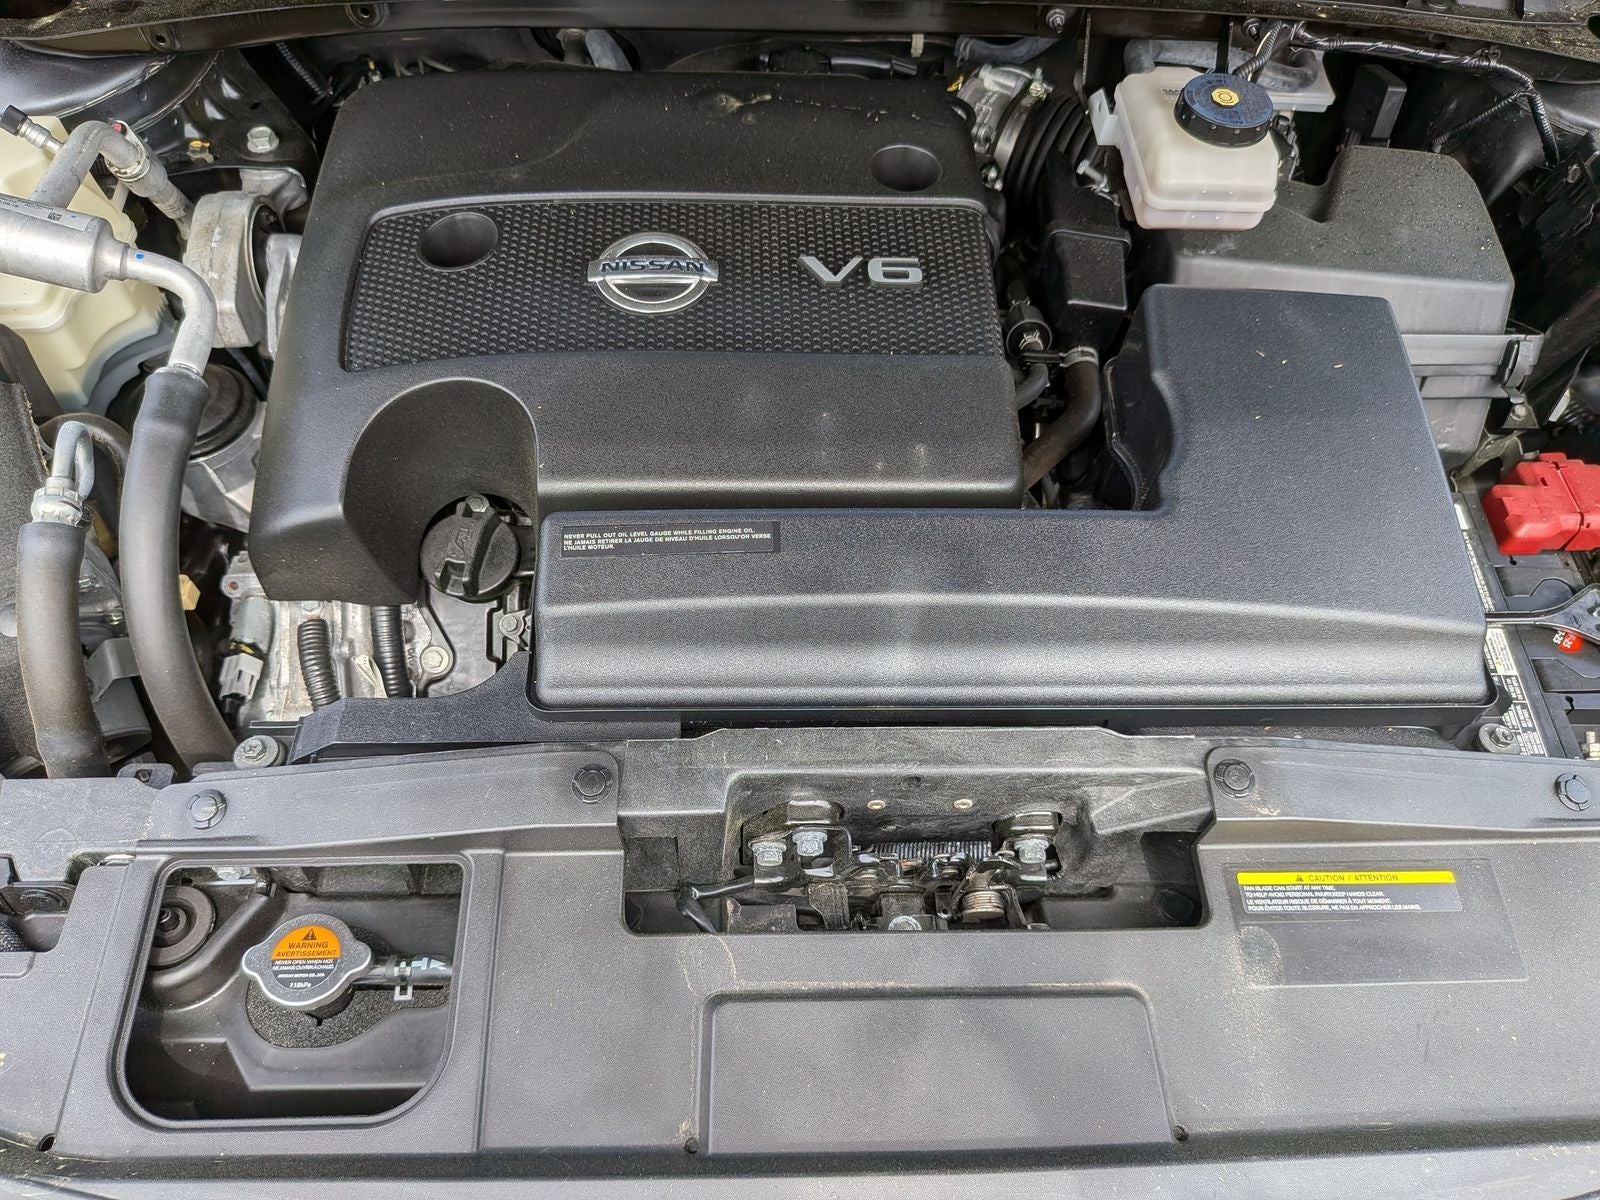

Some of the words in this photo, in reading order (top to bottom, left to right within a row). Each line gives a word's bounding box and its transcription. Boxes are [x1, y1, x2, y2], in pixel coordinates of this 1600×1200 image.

[601, 260, 705, 273] NISSAN
[798, 255, 923, 289] V6
[1308, 874, 1345, 882] CAUTION
[1354, 874, 1398, 882] ATTENTION
